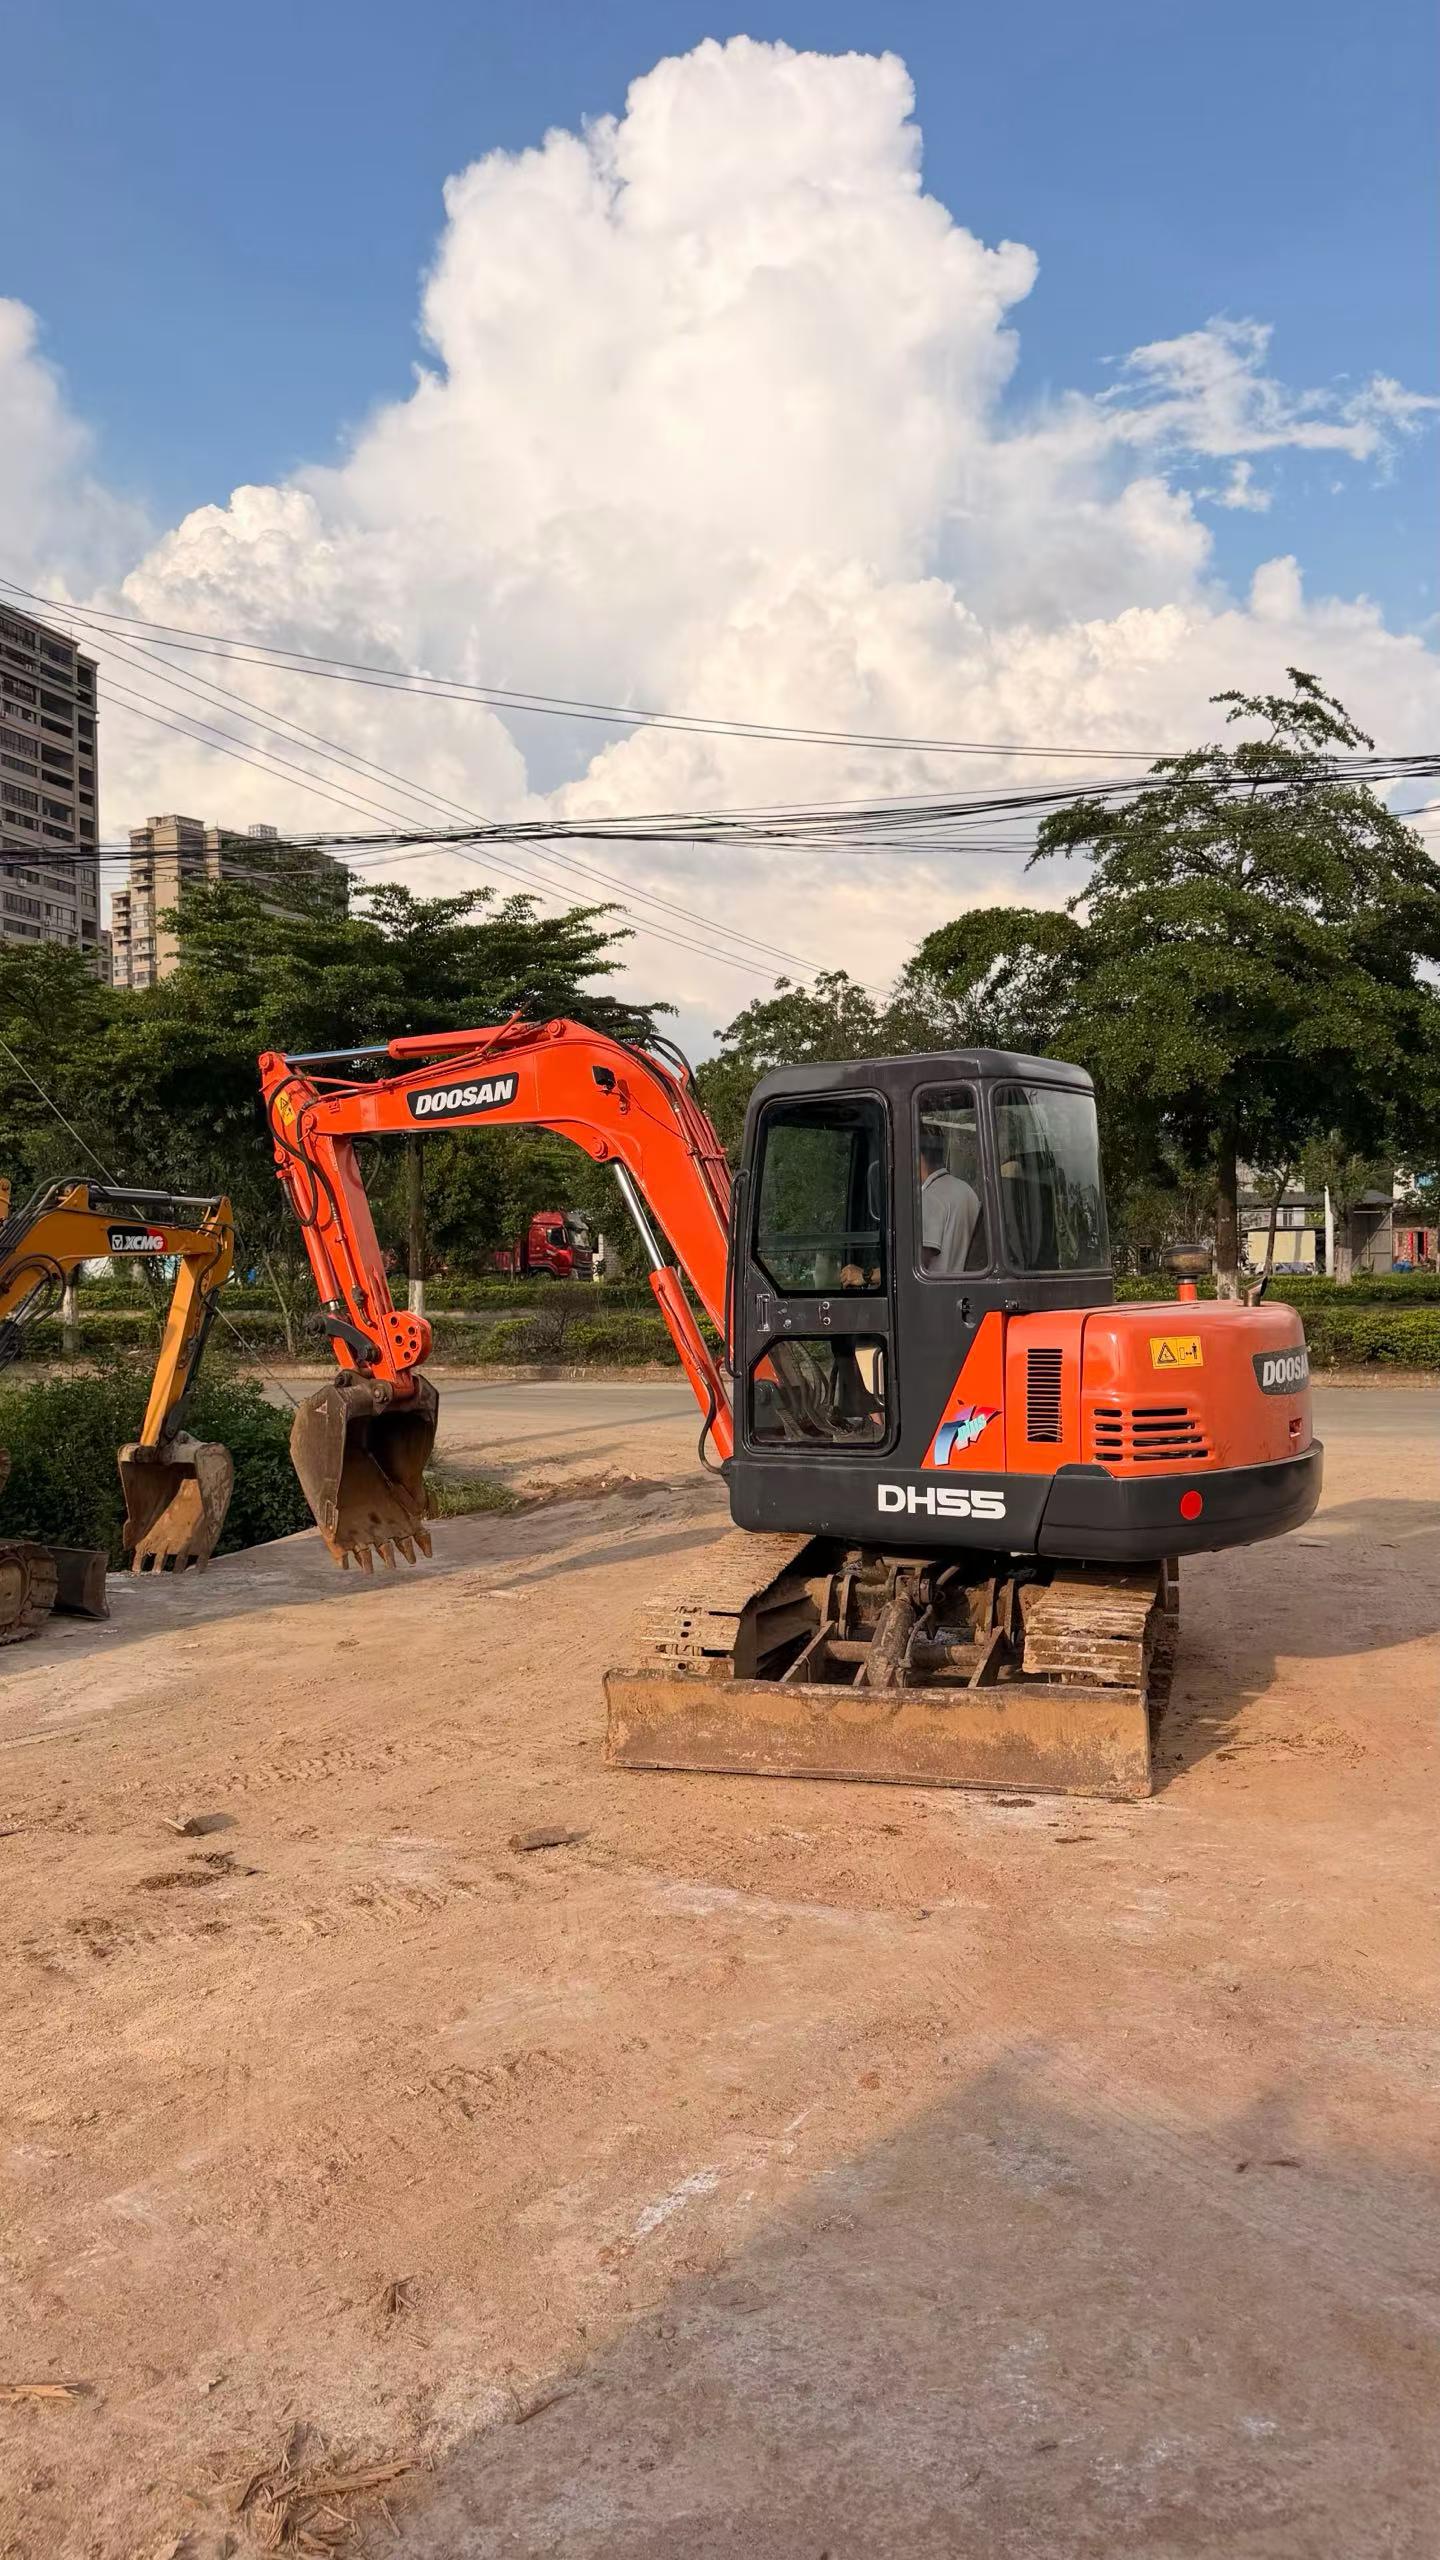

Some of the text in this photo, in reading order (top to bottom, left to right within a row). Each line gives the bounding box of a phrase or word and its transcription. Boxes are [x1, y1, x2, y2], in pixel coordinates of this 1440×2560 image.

[415, 1079, 513, 1115] DOOSAN
[123, 1235, 164, 1250] XCMG
[1263, 1352, 1309, 1387] DOOSA
[878, 1484, 1006, 1519] DH55
